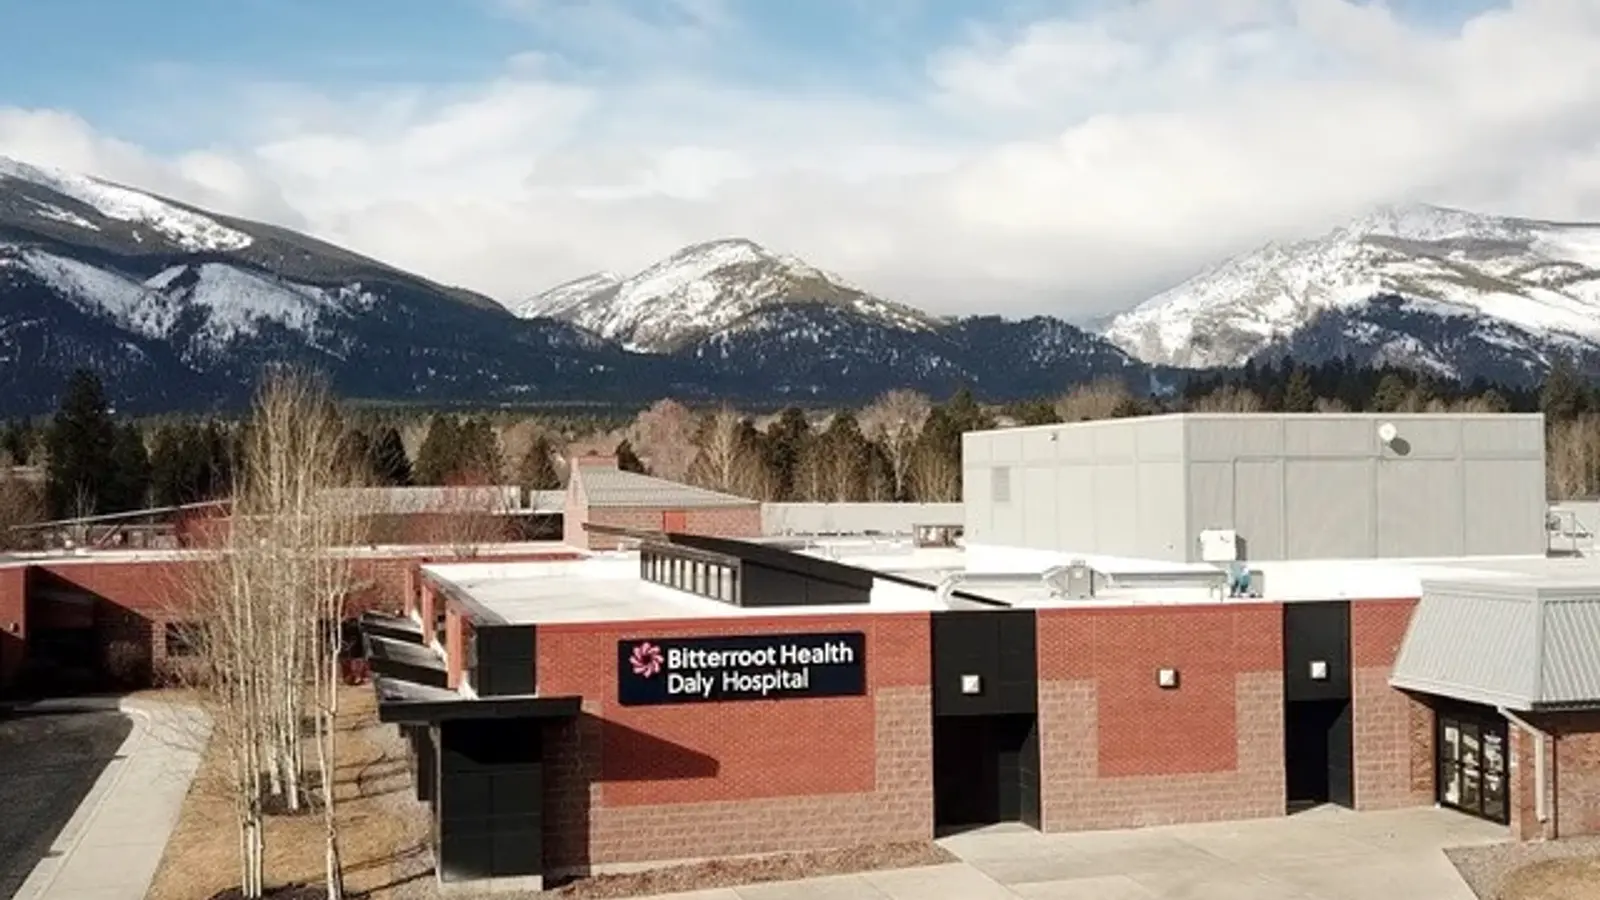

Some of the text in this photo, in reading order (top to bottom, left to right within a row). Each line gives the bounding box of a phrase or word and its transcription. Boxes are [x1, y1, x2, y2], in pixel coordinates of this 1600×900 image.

[667, 642, 854, 669] Bitterroot Health
[667, 668, 809, 698] Daly Hospital
